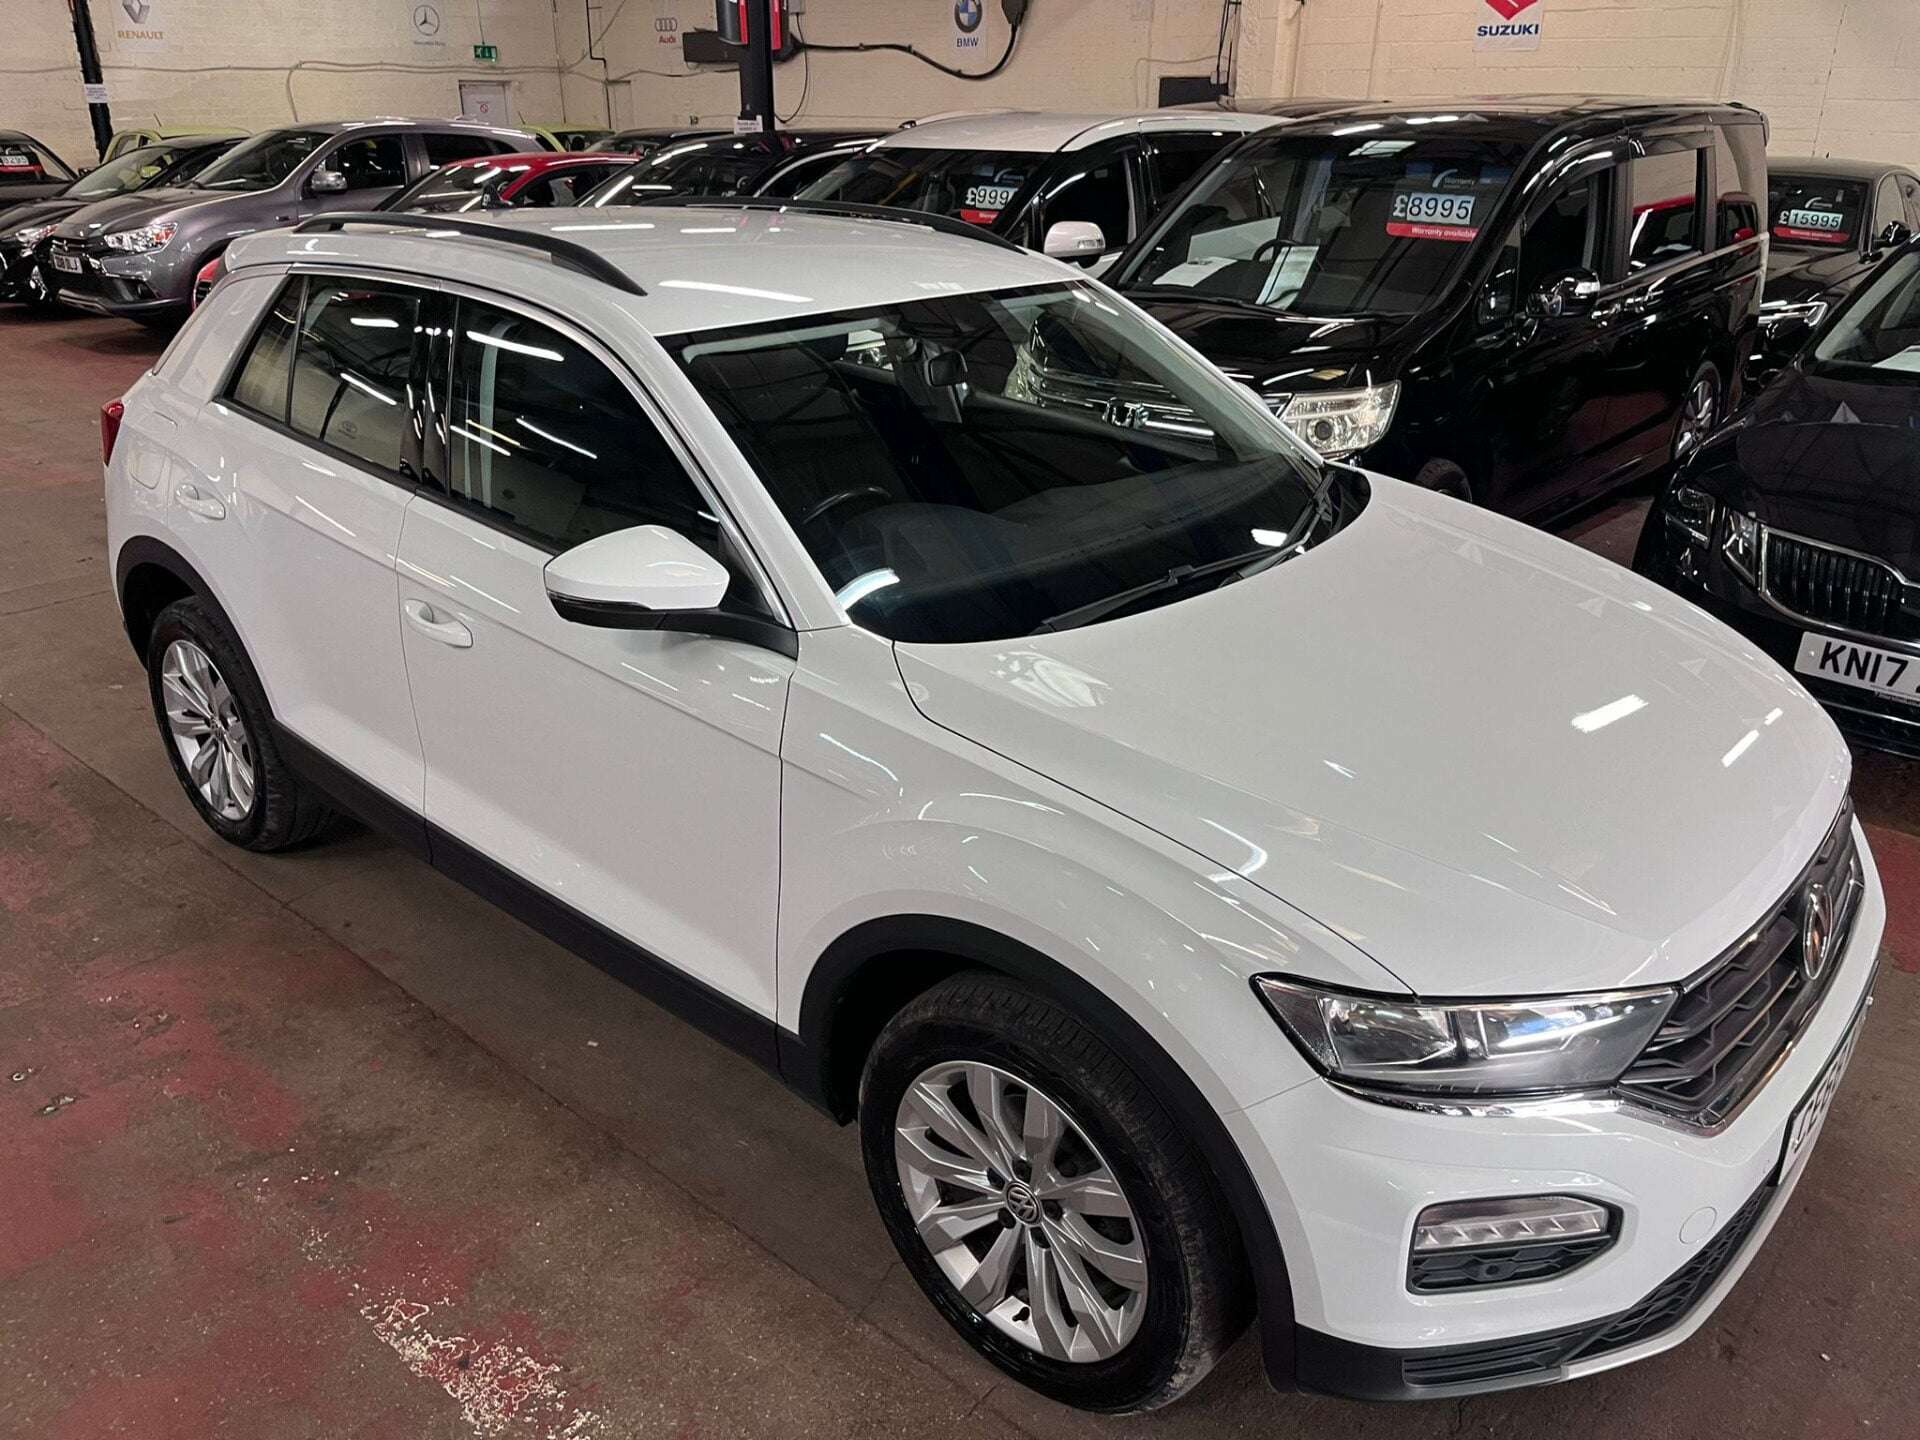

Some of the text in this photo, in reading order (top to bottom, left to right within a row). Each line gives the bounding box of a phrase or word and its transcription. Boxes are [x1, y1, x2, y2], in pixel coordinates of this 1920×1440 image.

[116, 30, 164, 40] RENAULT
[1476, 24, 1540, 37] SUZUKI
[658, 35, 677, 44] Audi
[956, 37, 979, 48] BMW
[965, 187, 1010, 205] £999
[1392, 194, 1471, 220] £8995
[1779, 210, 1840, 228] £15995
[1411, 227, 1443, 237] Warranty
[1818, 640, 1909, 688] KN17
